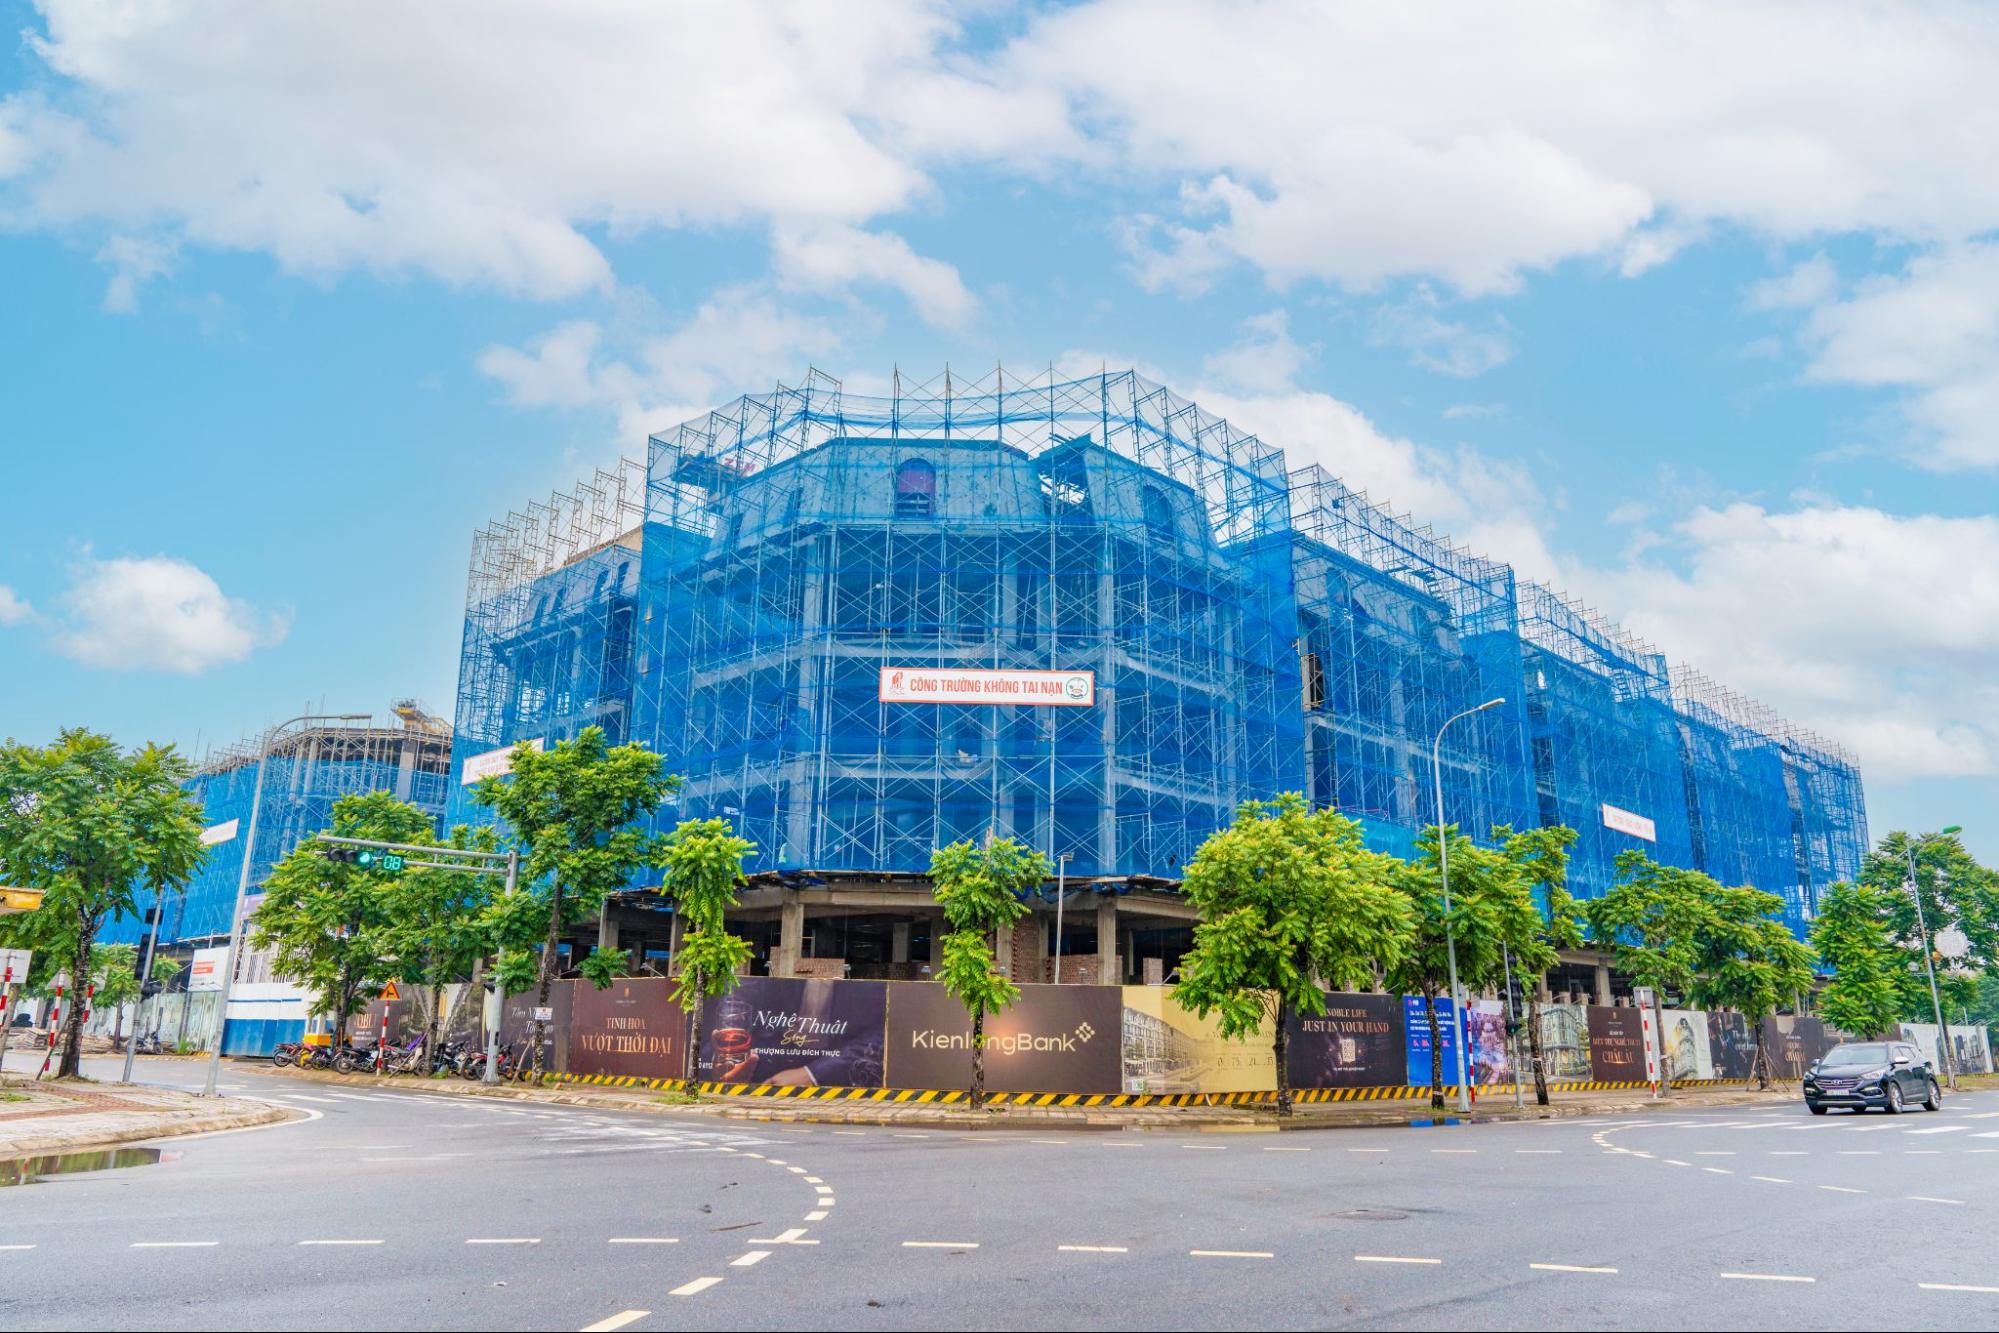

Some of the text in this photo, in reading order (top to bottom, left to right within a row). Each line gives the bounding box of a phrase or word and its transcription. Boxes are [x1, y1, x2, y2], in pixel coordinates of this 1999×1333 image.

[910, 677, 1063, 697] CÔNG TRƯỜNG KHÔNG TAI NẠN
[384, 855, 401, 870] 08
[1326, 1008, 1350, 1018] NOBLE
[606, 1017, 647, 1030] TINH HOA
[1302, 1020, 1389, 1033] JUST IN YOUR HAND
[581, 1031, 613, 1055] VƯỢT
[616, 1031, 646, 1054] THỜI
